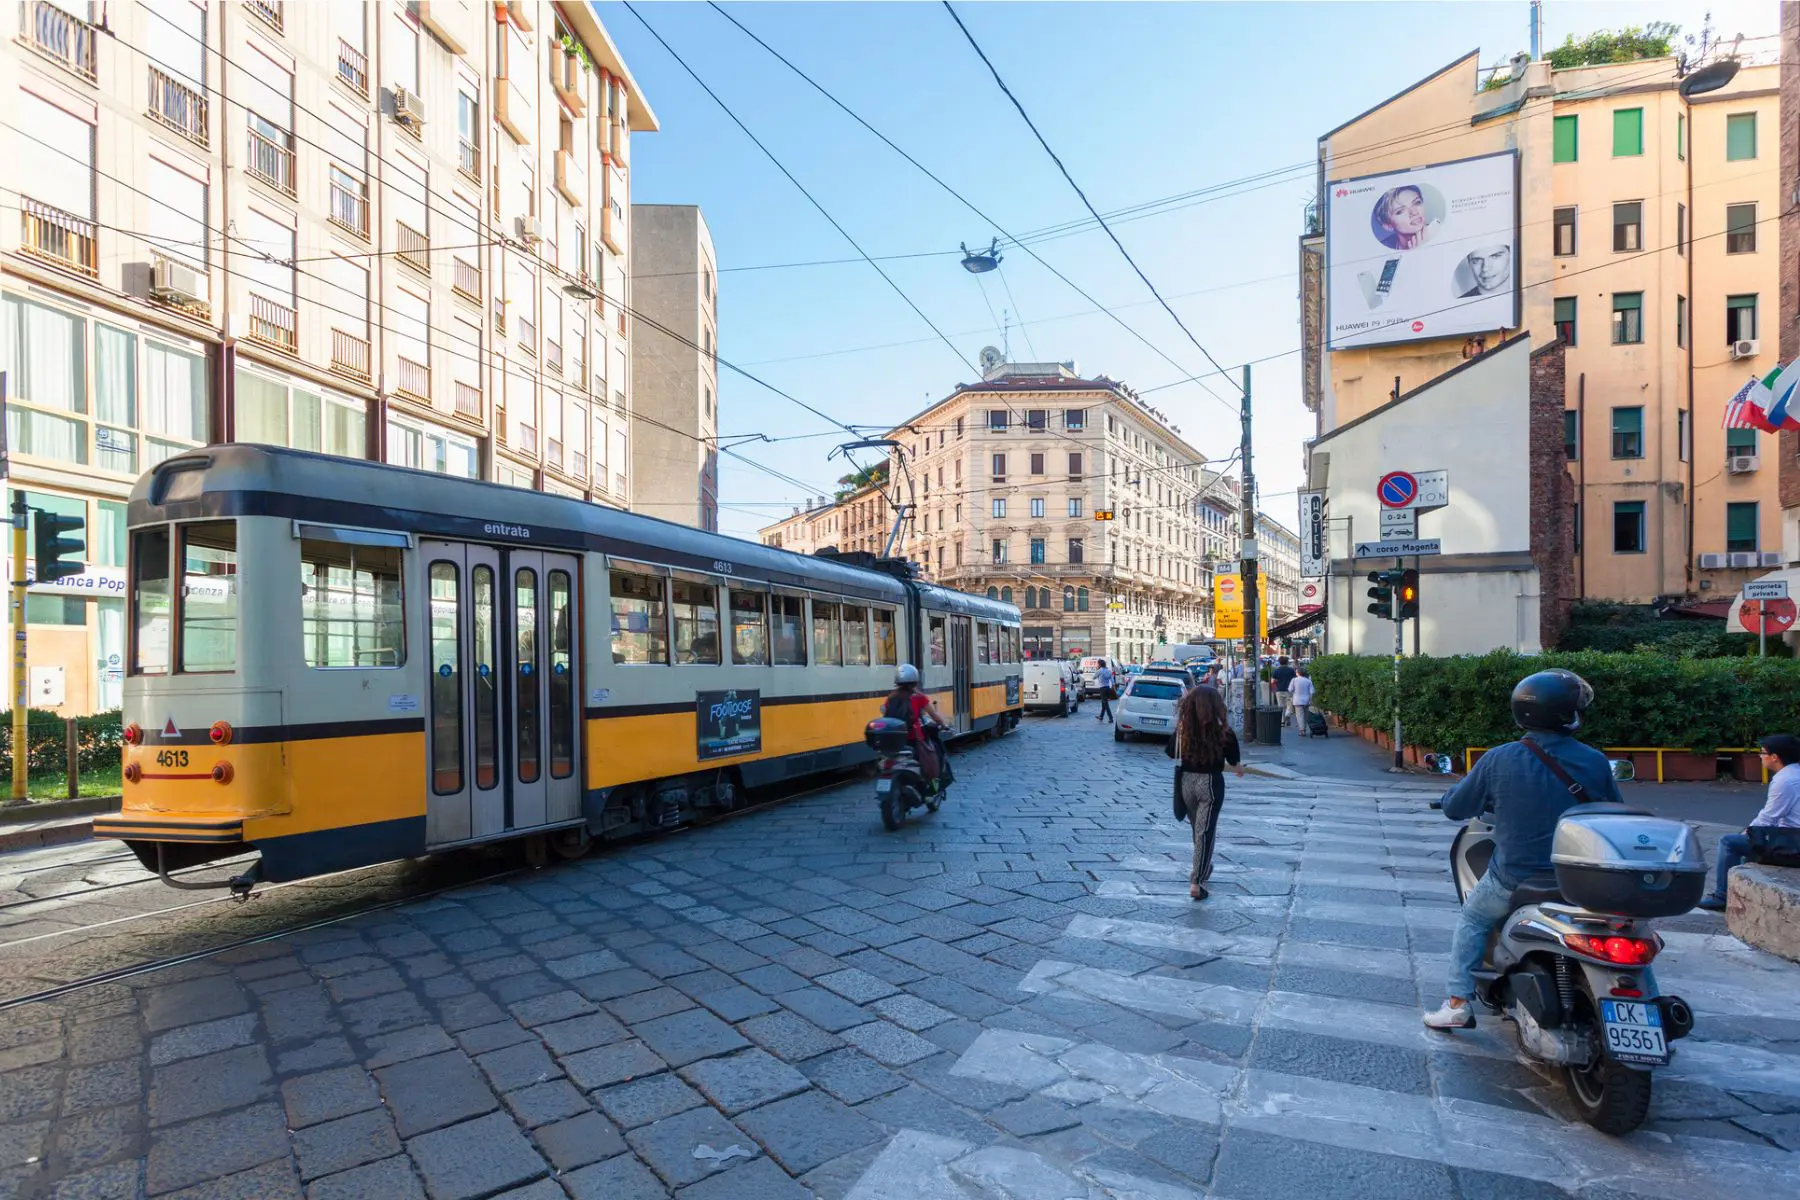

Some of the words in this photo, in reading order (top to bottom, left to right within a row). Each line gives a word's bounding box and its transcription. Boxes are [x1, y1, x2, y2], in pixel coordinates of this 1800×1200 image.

[1349, 186, 1376, 195] HUAWEI
[1336, 321, 1369, 332] HUAWEI
[484, 523, 530, 538] entrata
[1311, 499, 1321, 555] HOTEL
[1402, 542, 1439, 553] Magenta
[713, 560, 732, 574] 4613
[46, 575, 94, 588] anca
[710, 699, 752, 722] FOOTLOOSE
[156, 750, 189, 767] 4613
[1616, 1002, 1638, 1024] CK
[1609, 1027, 1663, 1052] 95361
